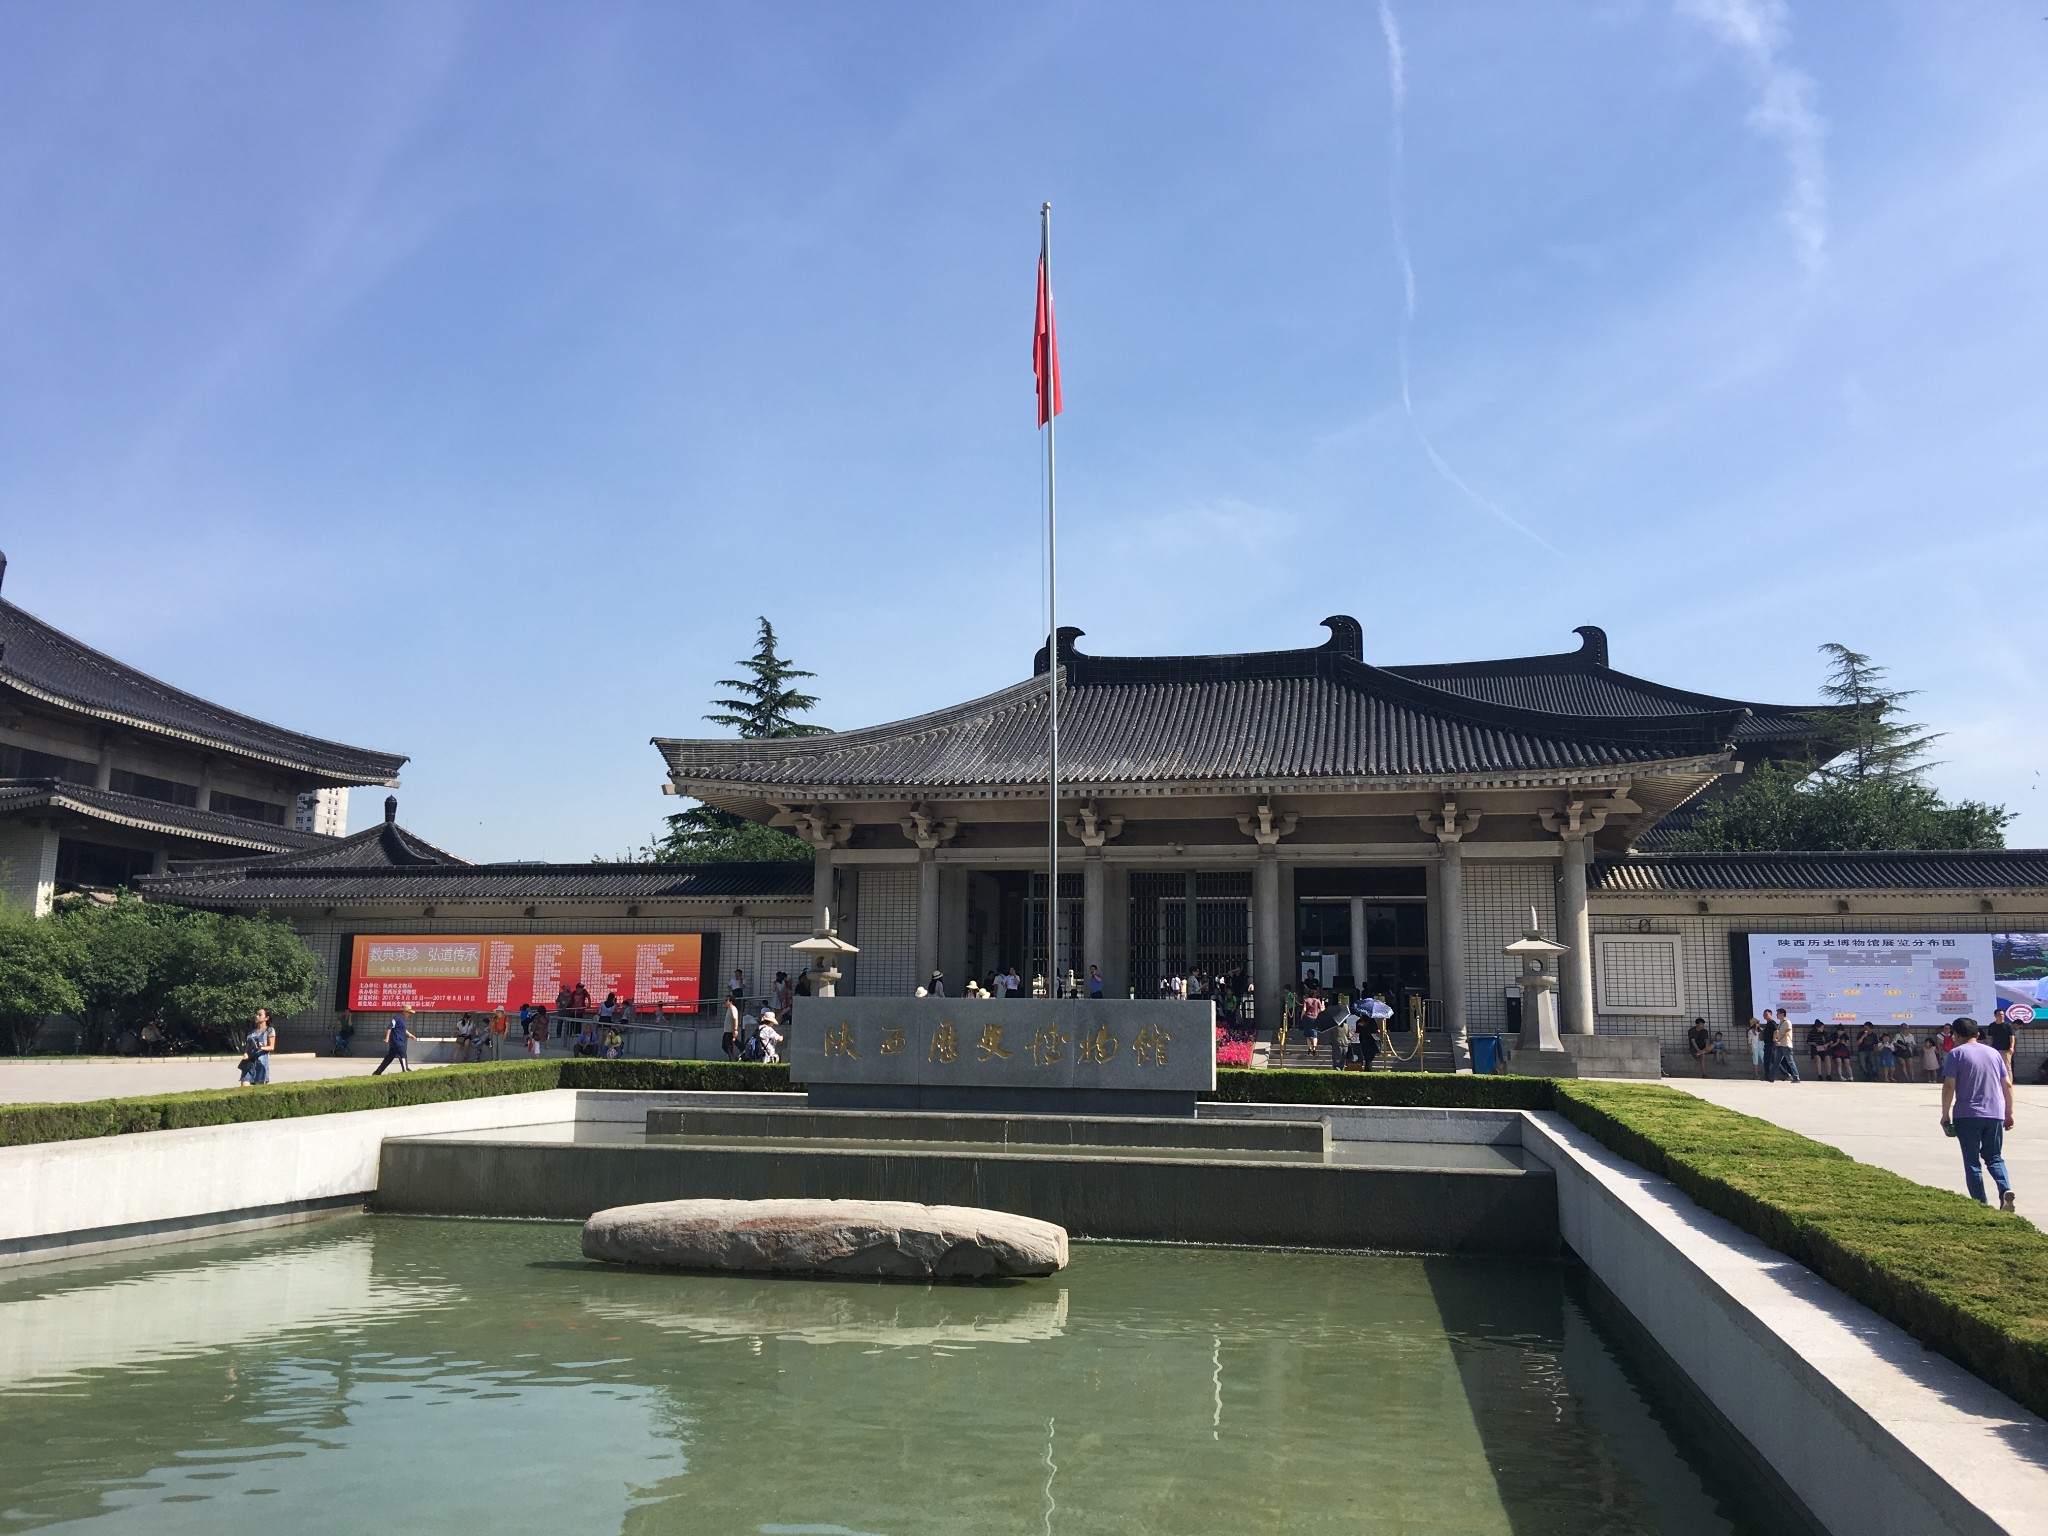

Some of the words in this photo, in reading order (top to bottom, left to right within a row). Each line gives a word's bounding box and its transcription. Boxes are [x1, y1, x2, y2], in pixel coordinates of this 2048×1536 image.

[1778, 939, 1956, 947] 陕西历史博物馆展览分布图
[370, 946, 419, 962] 数典录珍
[428, 946, 478, 962] 弘道传承
